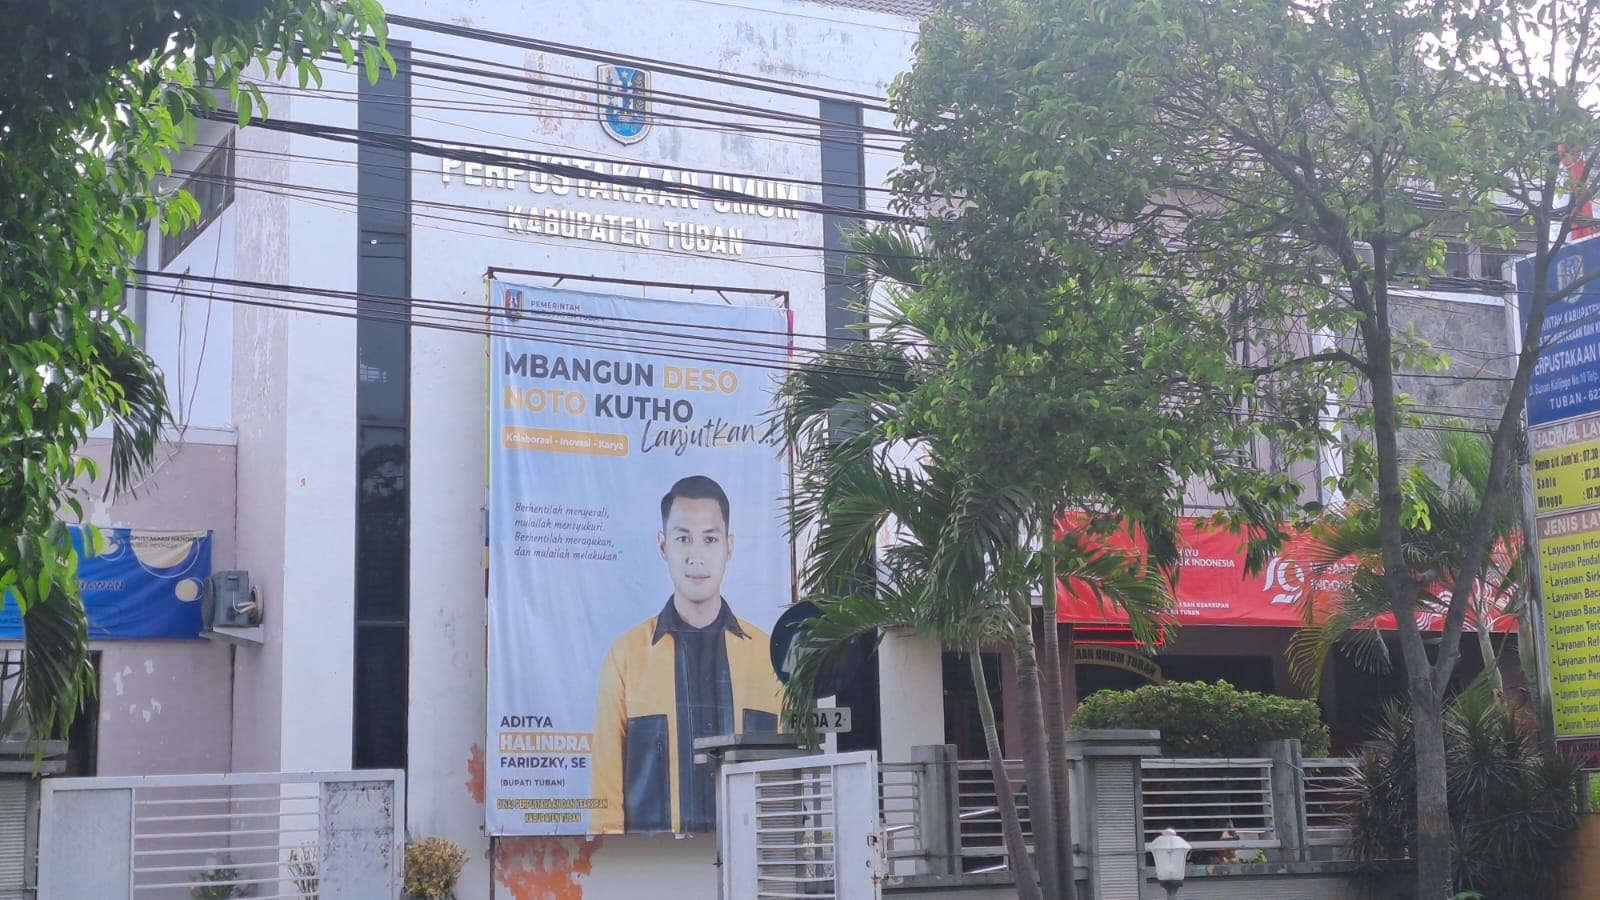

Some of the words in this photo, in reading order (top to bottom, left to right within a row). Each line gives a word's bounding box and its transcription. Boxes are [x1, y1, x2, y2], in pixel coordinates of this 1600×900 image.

[442, 144, 699, 209] PERPUSTAKAAN
[712, 175, 800, 219] UMUM
[507, 205, 650, 246] KABUPATEN
[664, 220, 743, 255] TUBAN
[531, 300, 580, 311] PEMERINTAH
[504, 352, 654, 387] MBANGUN
[663, 366, 738, 394] DESO
[504, 386, 586, 415] NOTO
[595, 394, 694, 423] KUTHO
[1550, 392, 1581, 410] TUBAN
[1535, 427, 1580, 448] JADWAL
[598, 440, 624, 451] Karya
[514, 502, 563, 514] Berhentilah
[565, 507, 609, 519] menyesali,
[1544, 517, 1578, 536] JENIS
[514, 531, 563, 544] Berhentilah
[565, 536, 615, 548] meragukan,
[514, 547, 531, 556] dan
[533, 547, 570, 559] mulailah
[1547, 545, 1580, 556] Layanan
[1192, 559, 1235, 568] INDONESIA
[1549, 561, 1576, 572] Layanan
[1550, 576, 1583, 588] Layanan
[1552, 592, 1583, 604] Layanan
[1553, 608, 1582, 620] Layanan
[1554, 623, 1584, 636] Layanan
[1556, 639, 1586, 652] Layanan
[1557, 655, 1587, 668] Layanan
[1558, 672, 1587, 684] Layanan
[500, 716, 553, 728] ADITYA
[834, 711, 842, 728] 2
[500, 734, 591, 751] HALINDRA
[500, 756, 568, 770] FARIDZKY,
[571, 757, 587, 769] SE
[500, 778, 532, 788] (BUPATI
[535, 779, 566, 788] TUBAN)
